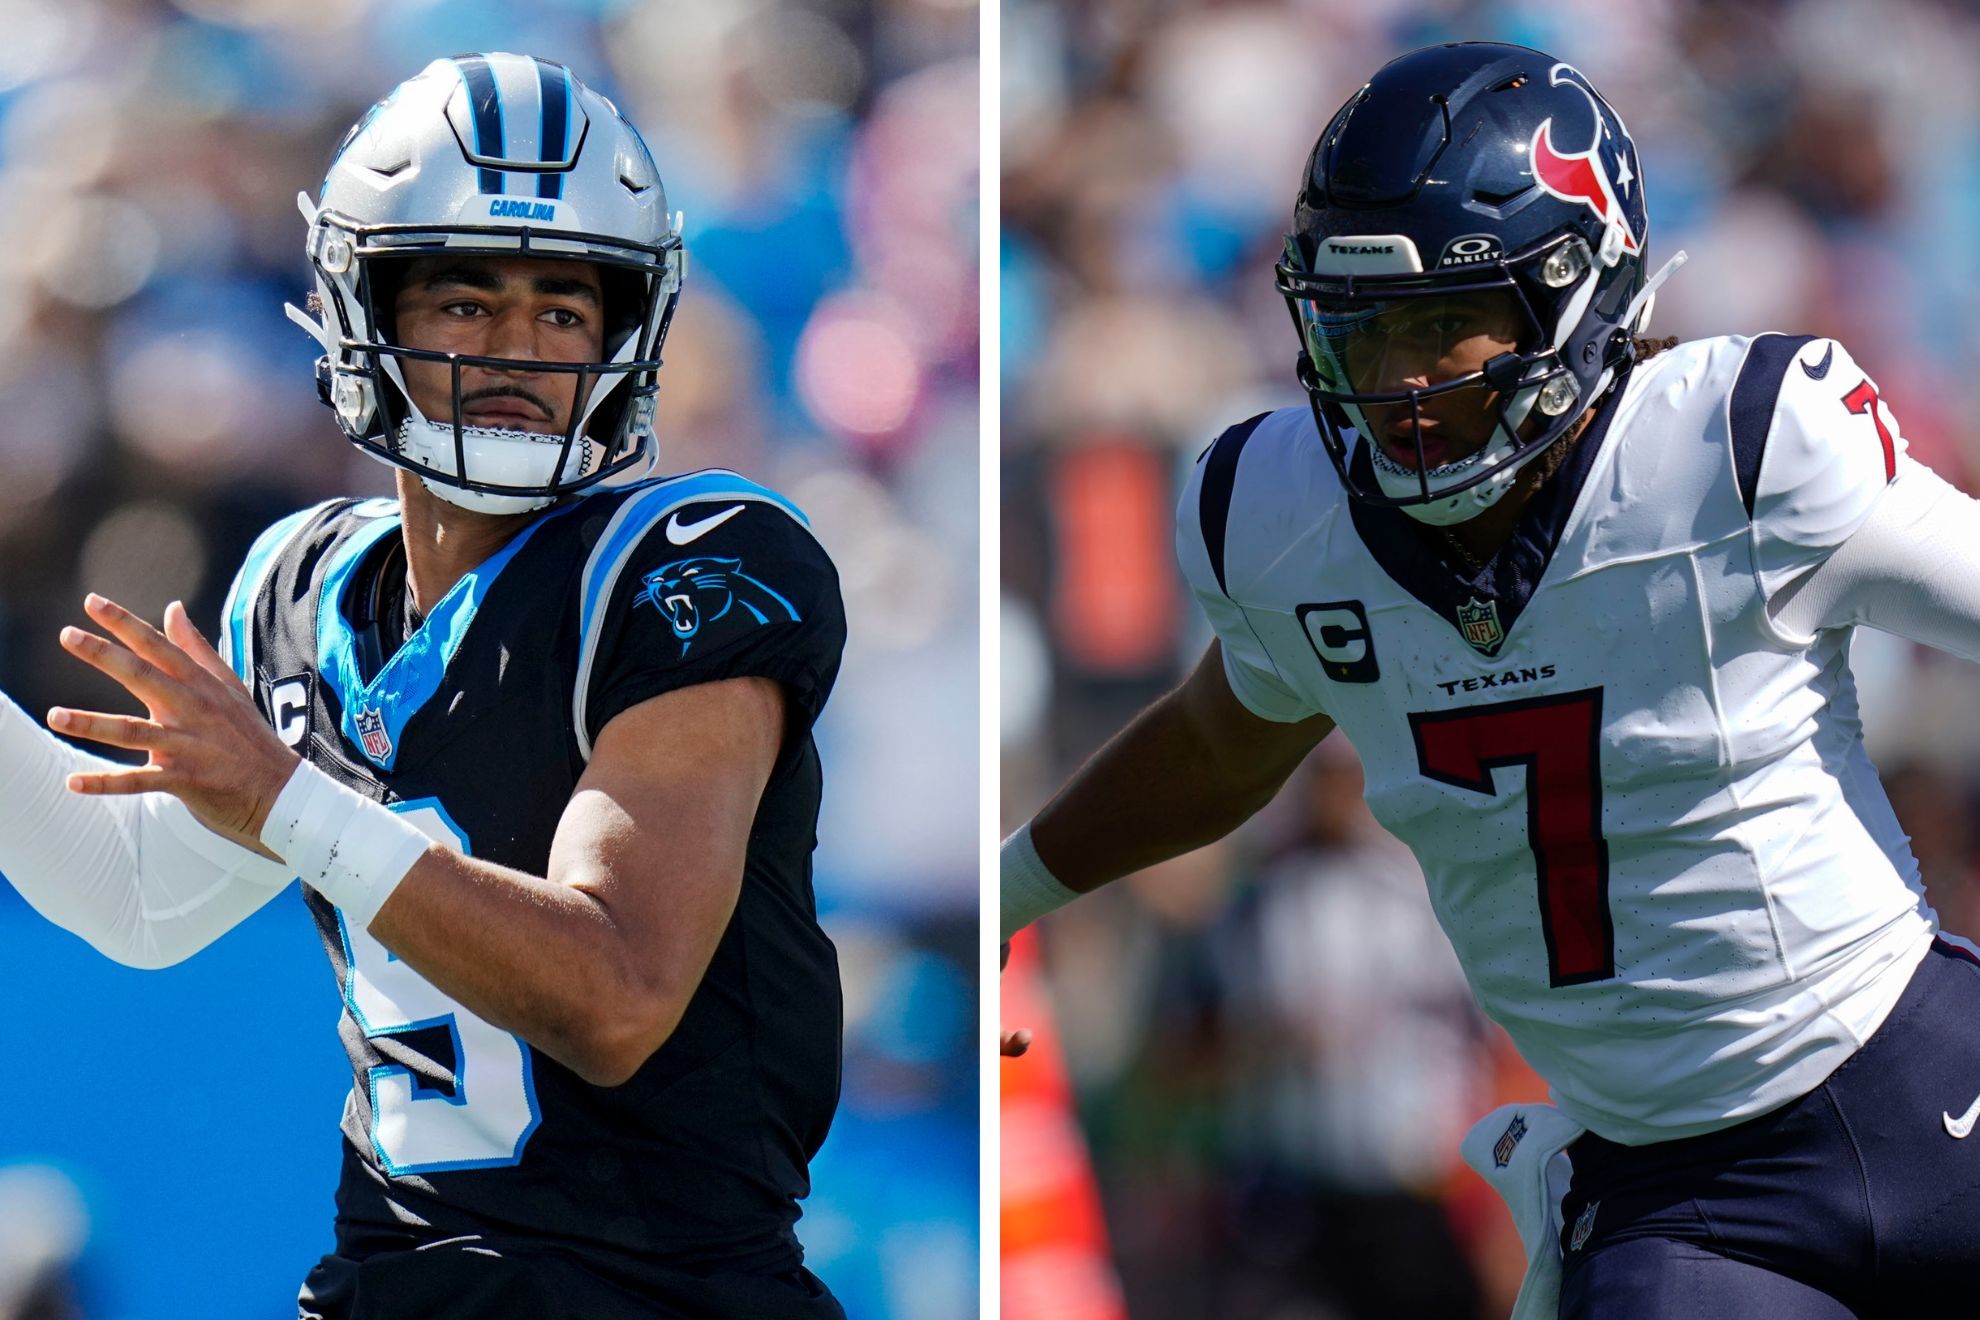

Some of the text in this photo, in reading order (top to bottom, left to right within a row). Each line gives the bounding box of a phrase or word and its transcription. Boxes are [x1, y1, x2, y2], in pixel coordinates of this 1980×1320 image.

[489, 199, 556, 221] CAROLINA
[1328, 244, 1395, 255] TEXANS
[1443, 251, 1500, 265] OAKLEY
[1840, 378, 1897, 485] 7
[1304, 608, 1367, 663] C
[1466, 622, 1497, 643] NFL
[1436, 664, 1557, 696] TEXANS
[271, 682, 307, 747] C
[363, 731, 388, 756] NFL
[1407, 685, 1616, 989] 7
